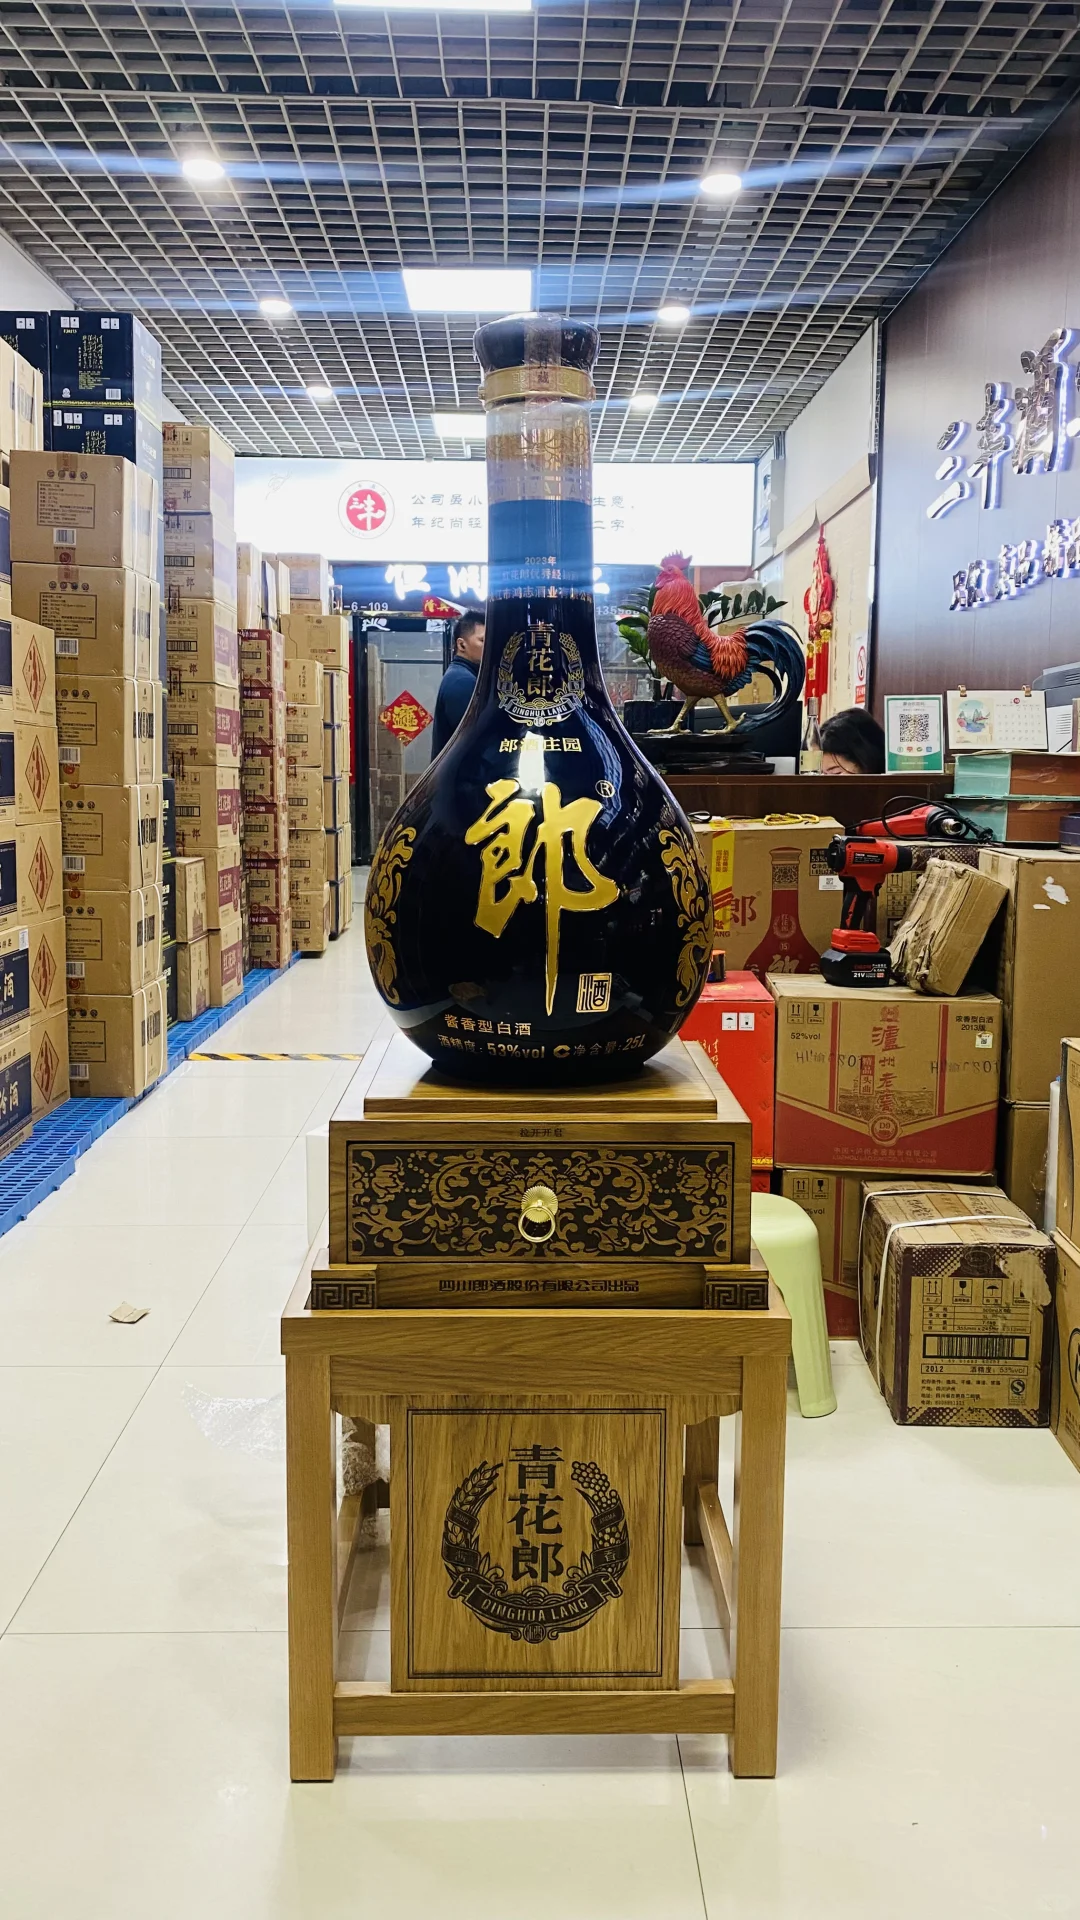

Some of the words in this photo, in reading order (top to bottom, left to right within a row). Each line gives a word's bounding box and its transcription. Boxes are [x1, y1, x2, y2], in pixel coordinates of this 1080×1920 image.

[411, 516, 483, 529] 年纪尚轻
[524, 555, 557, 566] 2023年
[527, 621, 555, 697] 青花郎
[465, 778, 621, 1016] 郎
[444, 1014, 532, 1037] 酱香型白酒
[790, 1032, 821, 1040] 52%vol
[438, 1279, 640, 1293] 四川郎酒股份有限公司出品
[507, 1444, 565, 1583] 青花郎
[550, 1597, 589, 1620] LANG
